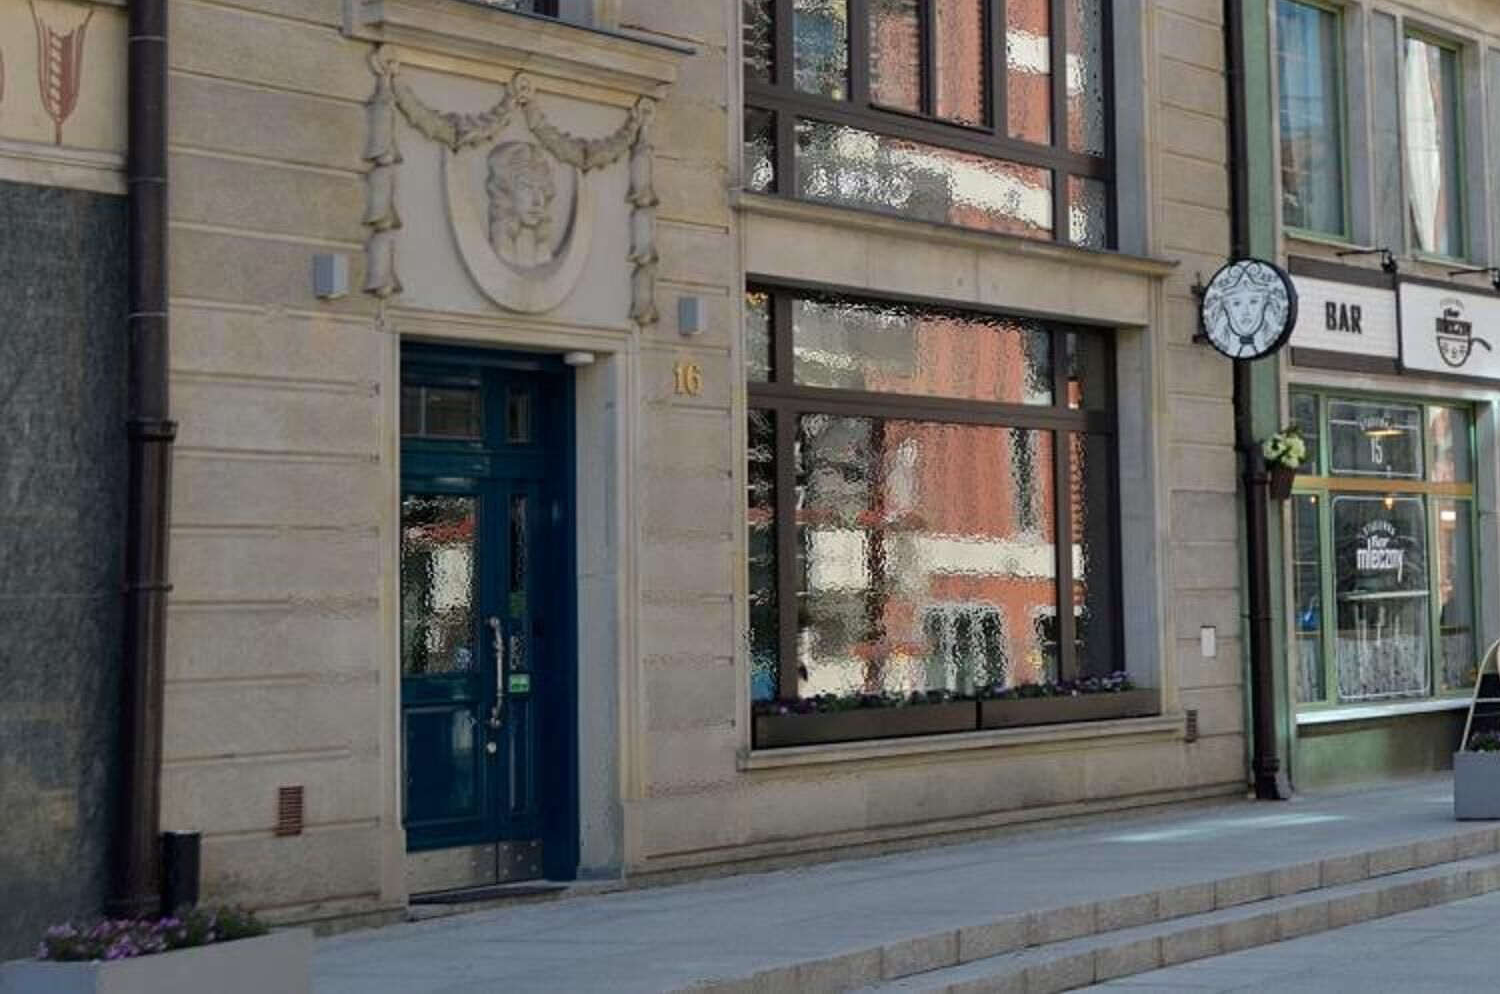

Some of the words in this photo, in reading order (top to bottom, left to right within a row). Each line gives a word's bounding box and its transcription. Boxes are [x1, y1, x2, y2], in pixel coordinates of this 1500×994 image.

[1325, 301, 1362, 334] BAR
[674, 363, 703, 397] 16
[1371, 437, 1383, 464] 15
